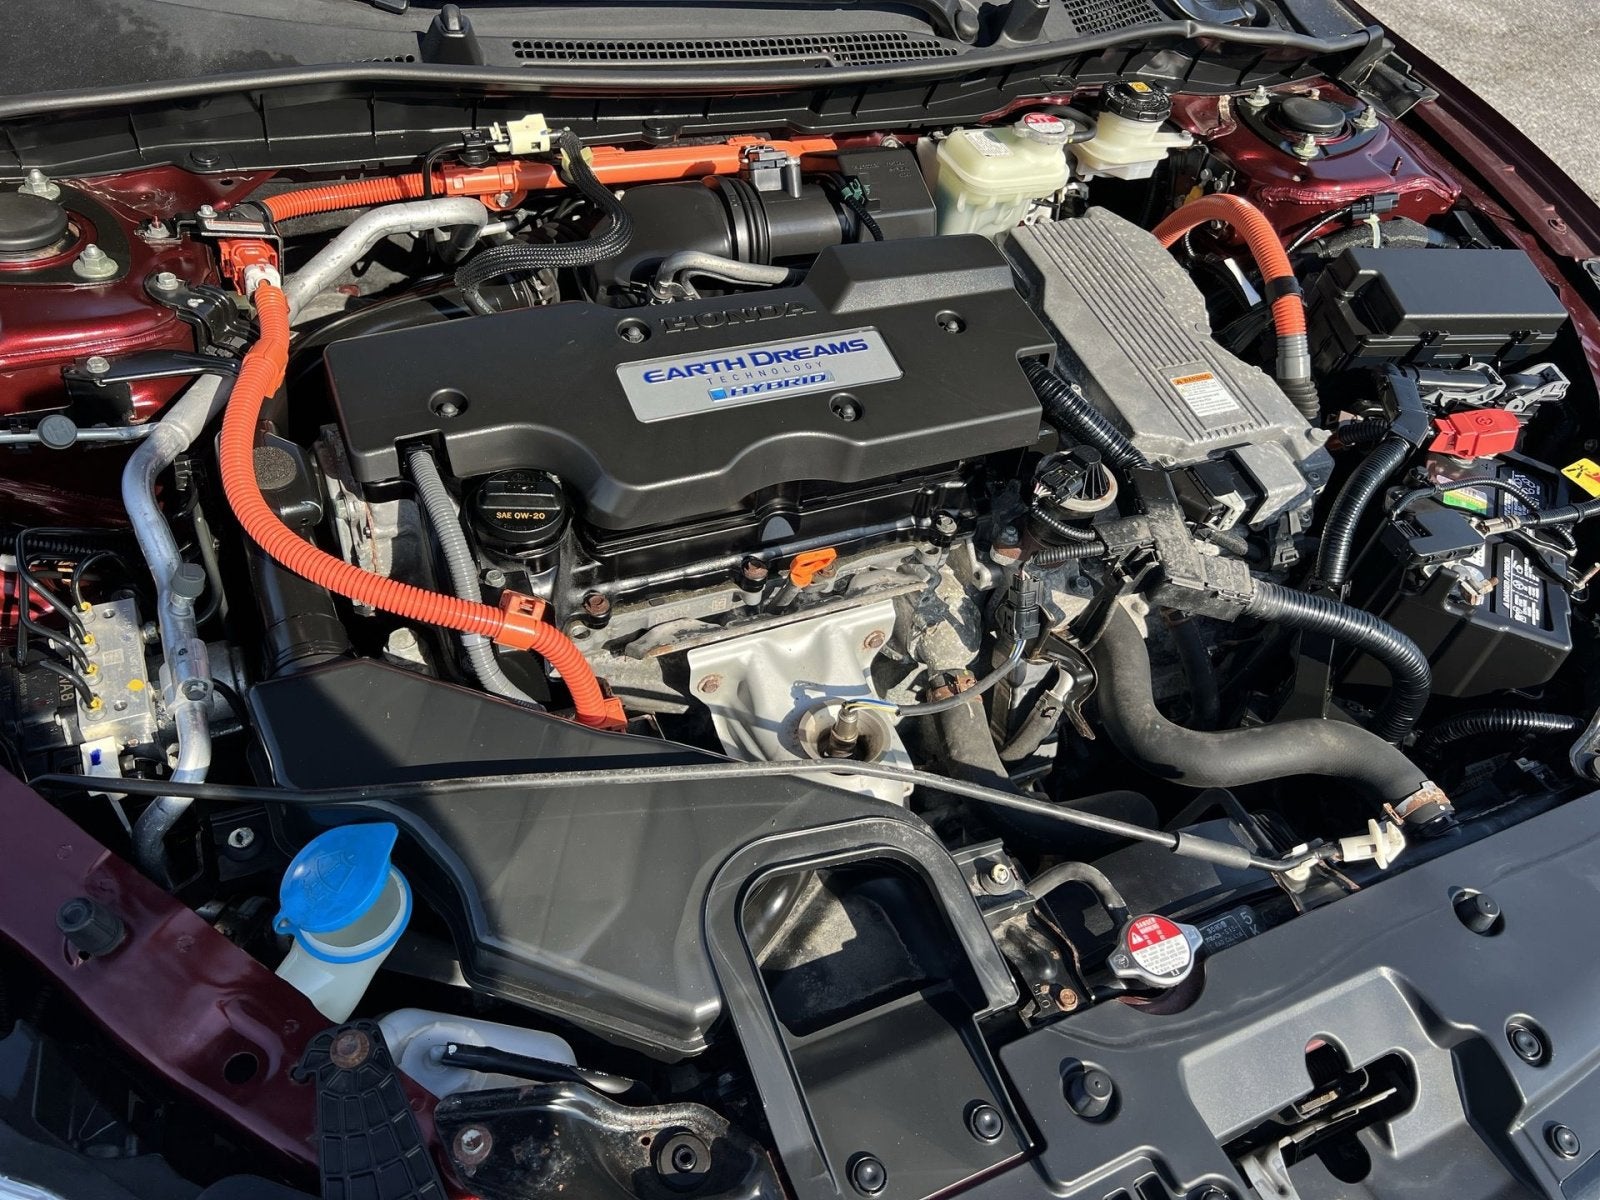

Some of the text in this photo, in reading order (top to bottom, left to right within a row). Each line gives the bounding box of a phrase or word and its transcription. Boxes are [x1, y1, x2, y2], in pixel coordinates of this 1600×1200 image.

[659, 302, 817, 334] HONDA
[643, 338, 869, 385] EARTH DREAMS
[706, 361, 823, 385] TECHNOLOGY
[730, 372, 827, 397] HYBRID
[496, 511, 546, 520] SAE 0W-20
[1240, 911, 1253, 925] 5
